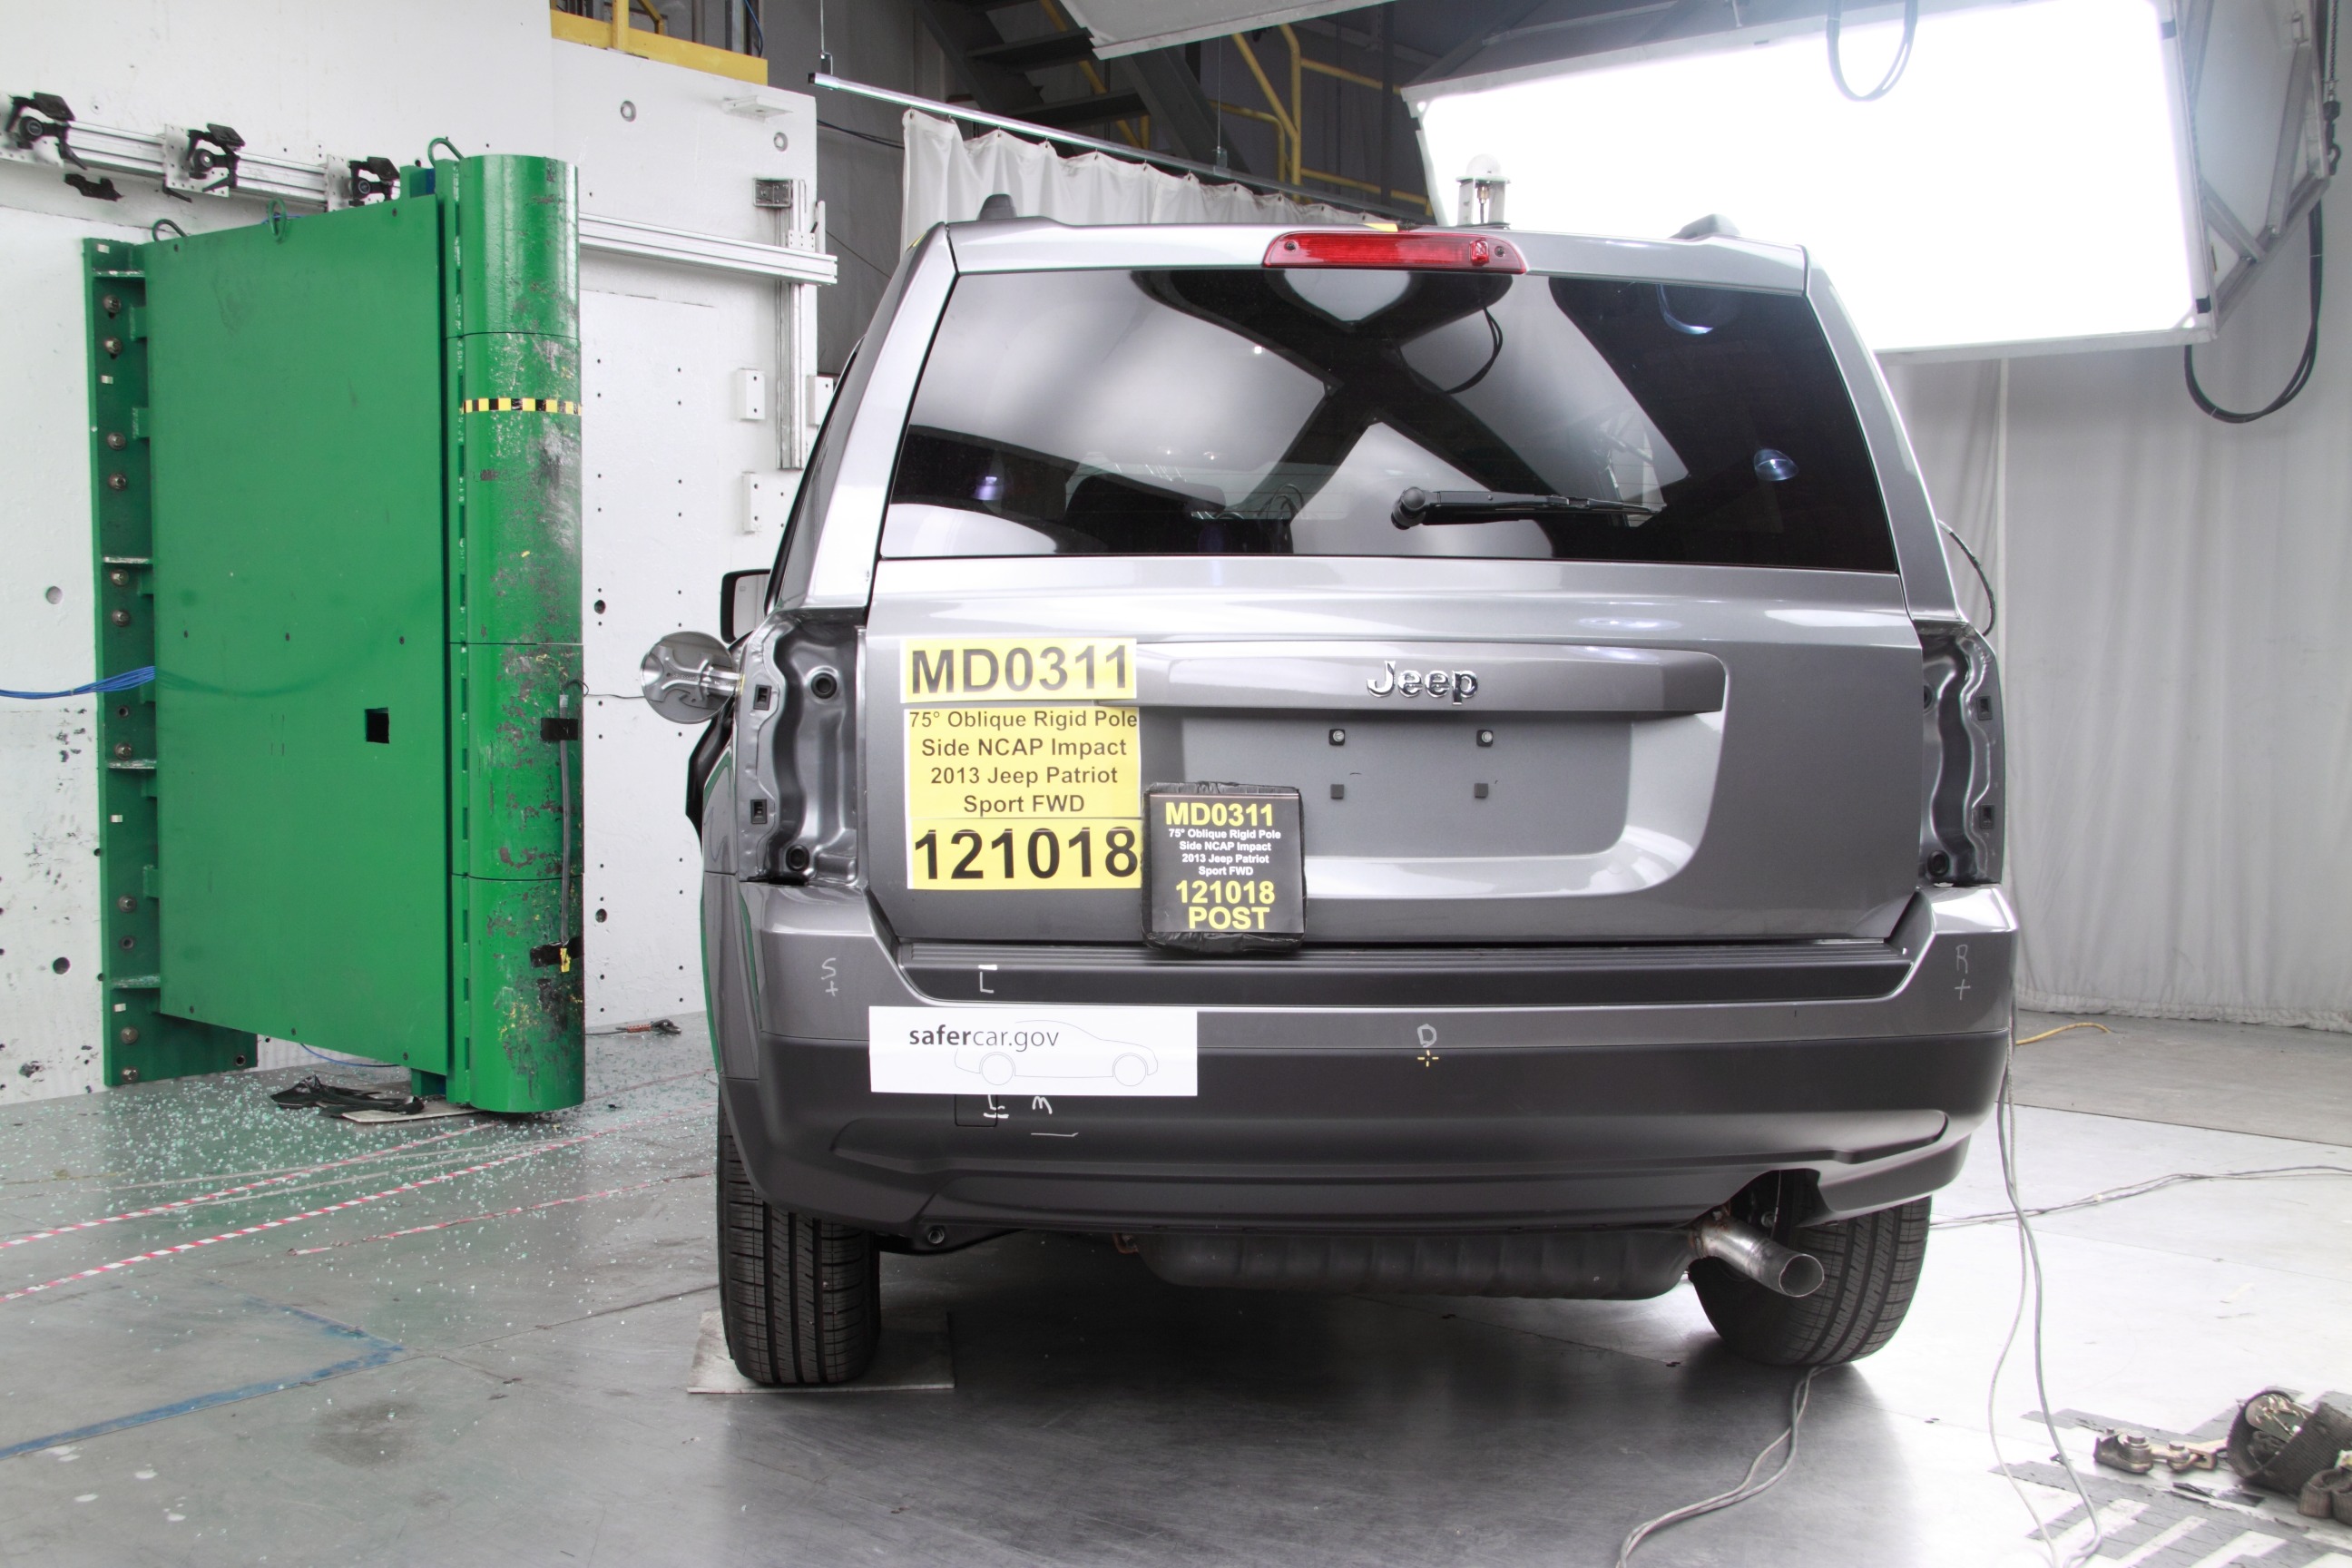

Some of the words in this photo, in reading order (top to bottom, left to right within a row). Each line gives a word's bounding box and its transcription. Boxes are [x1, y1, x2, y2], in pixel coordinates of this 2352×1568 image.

[912, 645, 1126, 694] MD0311
[1367, 661, 1478, 705] Jeep
[909, 710, 940, 728] 75°
[947, 710, 1026, 730] Oblique
[1034, 710, 1086, 730] Rigid
[1094, 710, 1138, 728] Pole
[921, 739, 970, 756] Side
[978, 738, 1044, 756] NCAP
[1052, 738, 1127, 760] Impact
[931, 767, 980, 784] 2013
[987, 767, 1038, 788] Jeep
[1046, 766, 1118, 784] Patriot
[964, 795, 1024, 817] Sport
[1033, 794, 1085, 812] FWD
[1165, 802, 1273, 827] MD0311
[1169, 828, 1185, 838] 75°
[1187, 828, 1227, 839] Oblique
[1230, 829, 1256, 840] Rigid
[1259, 830, 1281, 838] Pole
[915, 826, 1138, 880] 121018
[1179, 841, 1202, 850] Side
[1204, 842, 1234, 851] NCAP
[1237, 842, 1272, 852] Impact
[1181, 854, 1206, 863] 2013
[1208, 854, 1233, 864] Jeep
[1235, 854, 1269, 863] Patriot
[1199, 866, 1227, 877] Sport
[1229, 867, 1254, 876] FWD
[1176, 880, 1276, 904] 121018
[1188, 906, 1270, 930] POST
[908, 1024, 1059, 1052] safercar.gov
